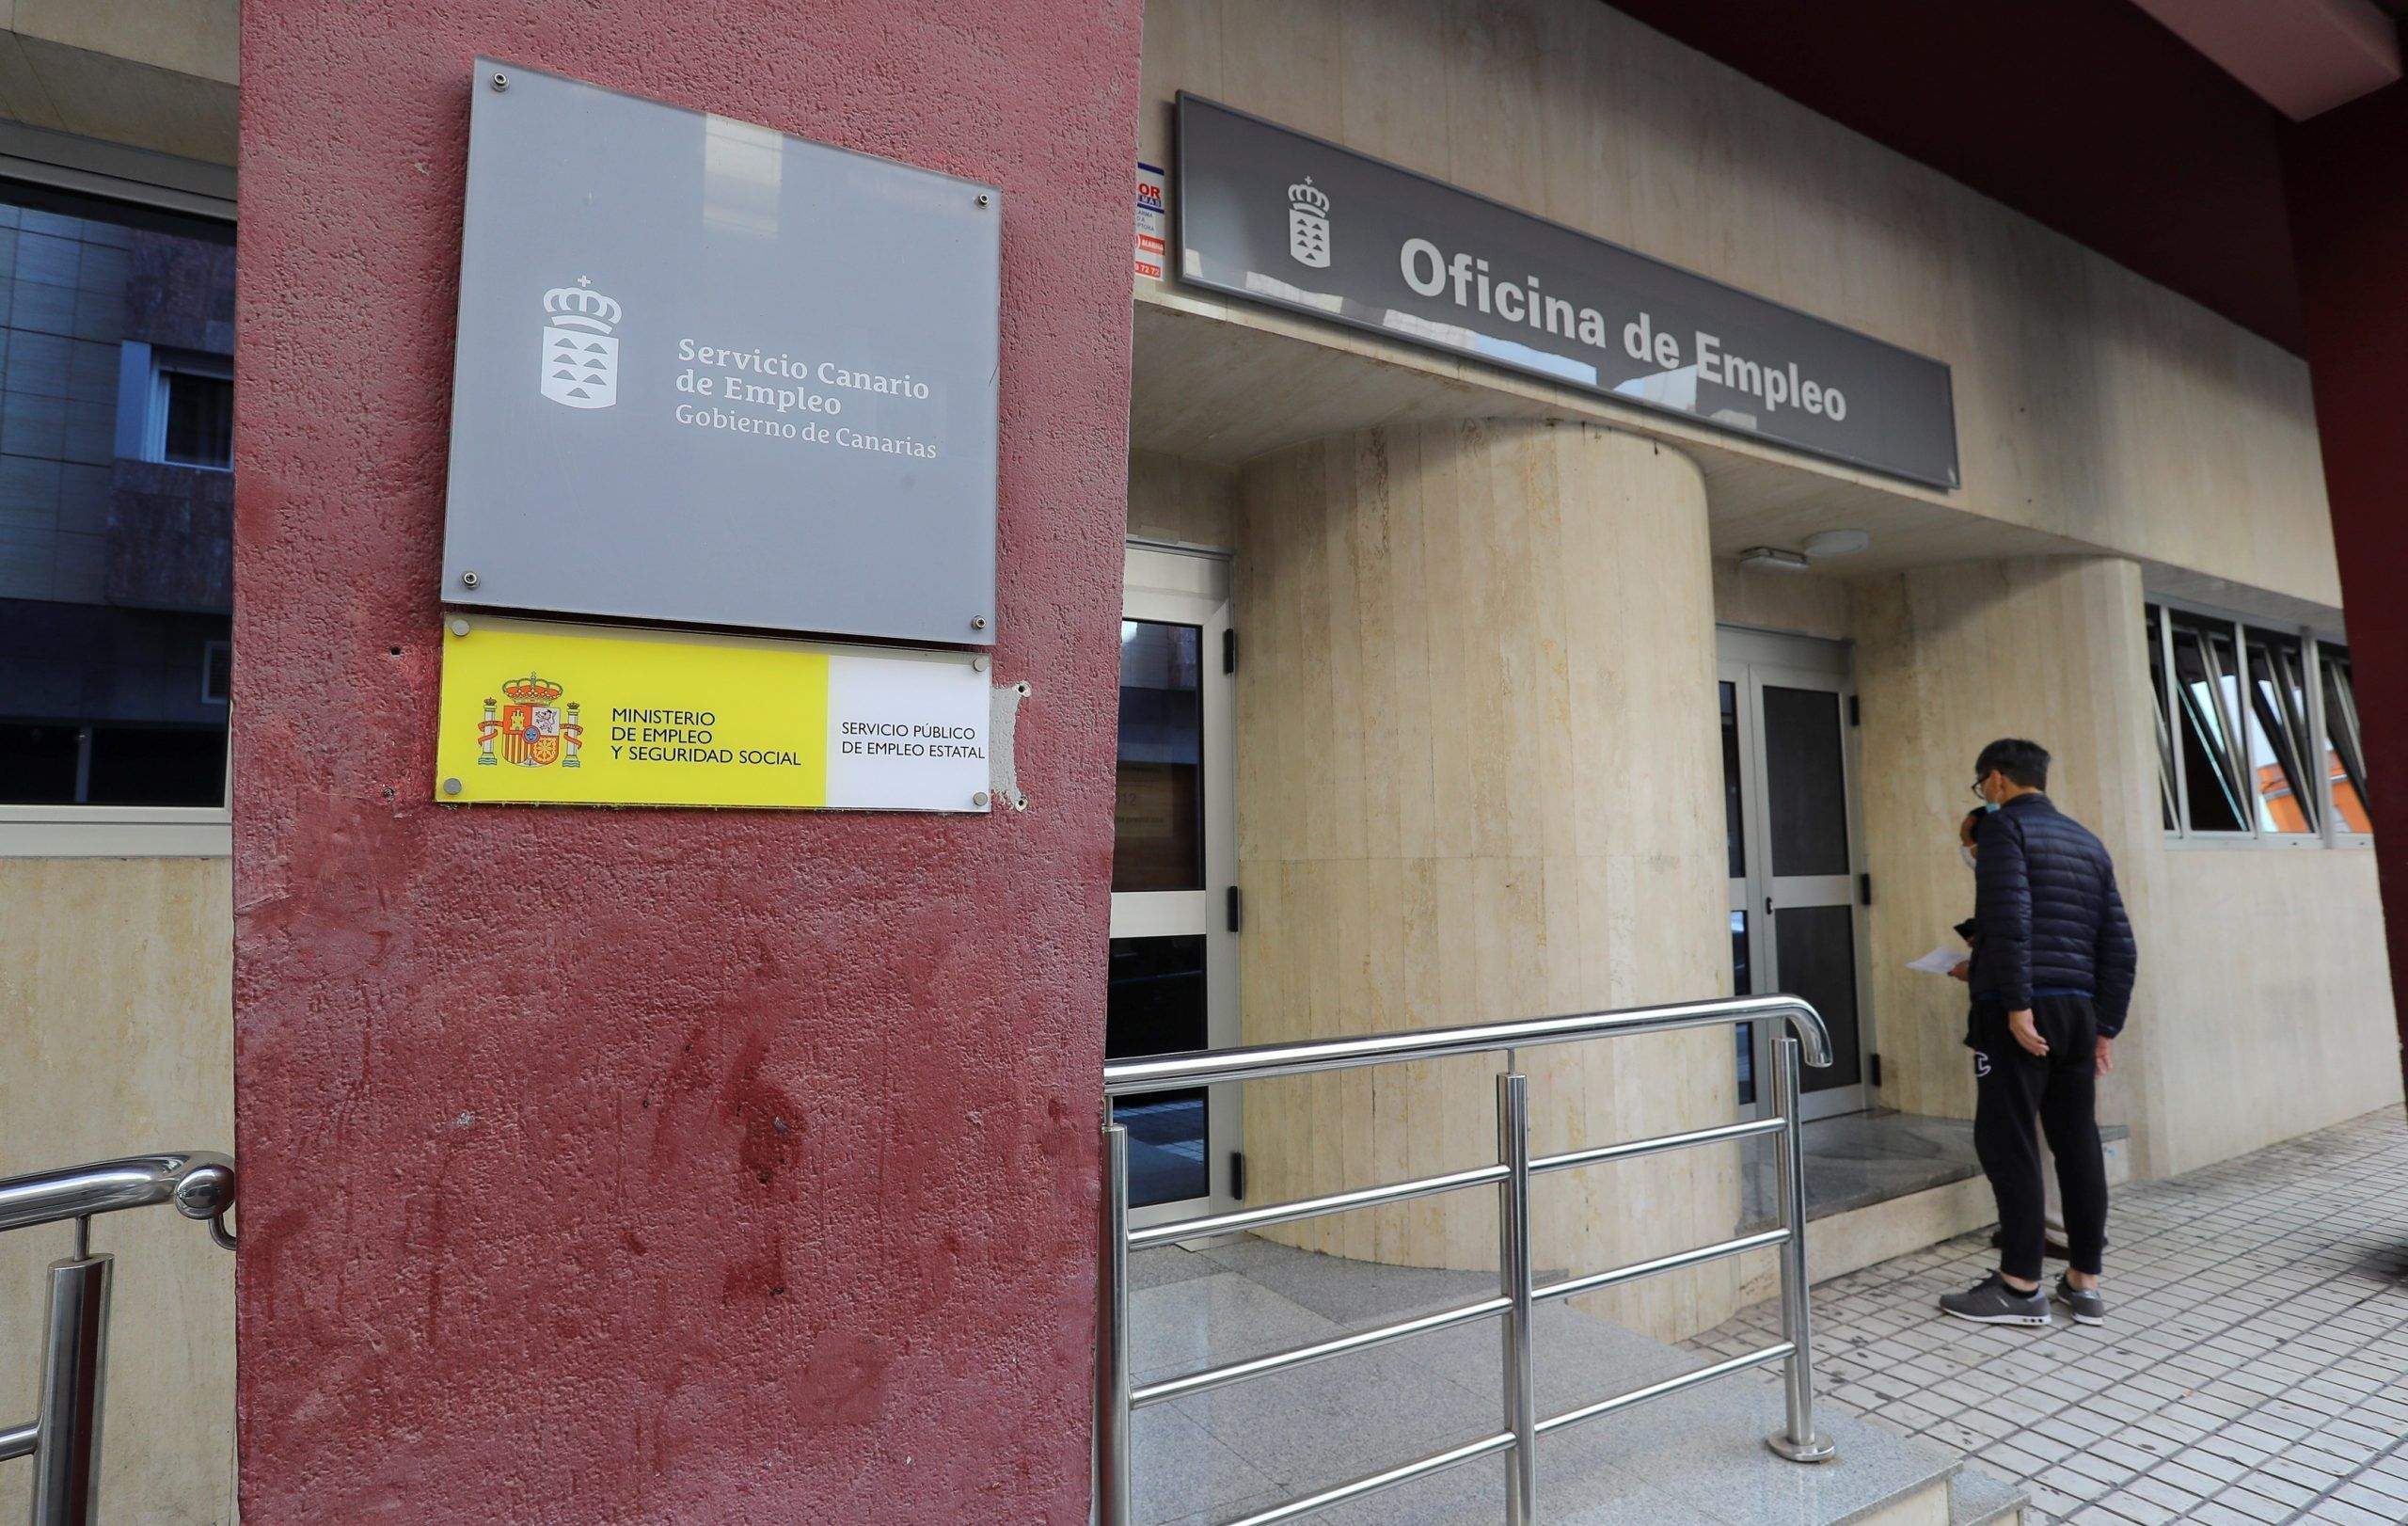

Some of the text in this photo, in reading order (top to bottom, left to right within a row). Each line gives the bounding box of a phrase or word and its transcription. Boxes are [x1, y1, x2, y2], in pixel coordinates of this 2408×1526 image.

[1400, 238, 1846, 421] Oficina de Empleo
[677, 338, 929, 400] Servicio Canario
[675, 368, 842, 415] de Empleo
[674, 404, 938, 459] Gobierno de Canarias
[611, 707, 716, 726] MINISTERIO
[611, 726, 713, 745] DE EMPLEO
[841, 721, 975, 740] SERVICIO PÚBLICO
[610, 745, 802, 766] Y SEGURIDAD SOCIAL
[842, 740, 986, 759] DE EMPLEO ESTATAL
